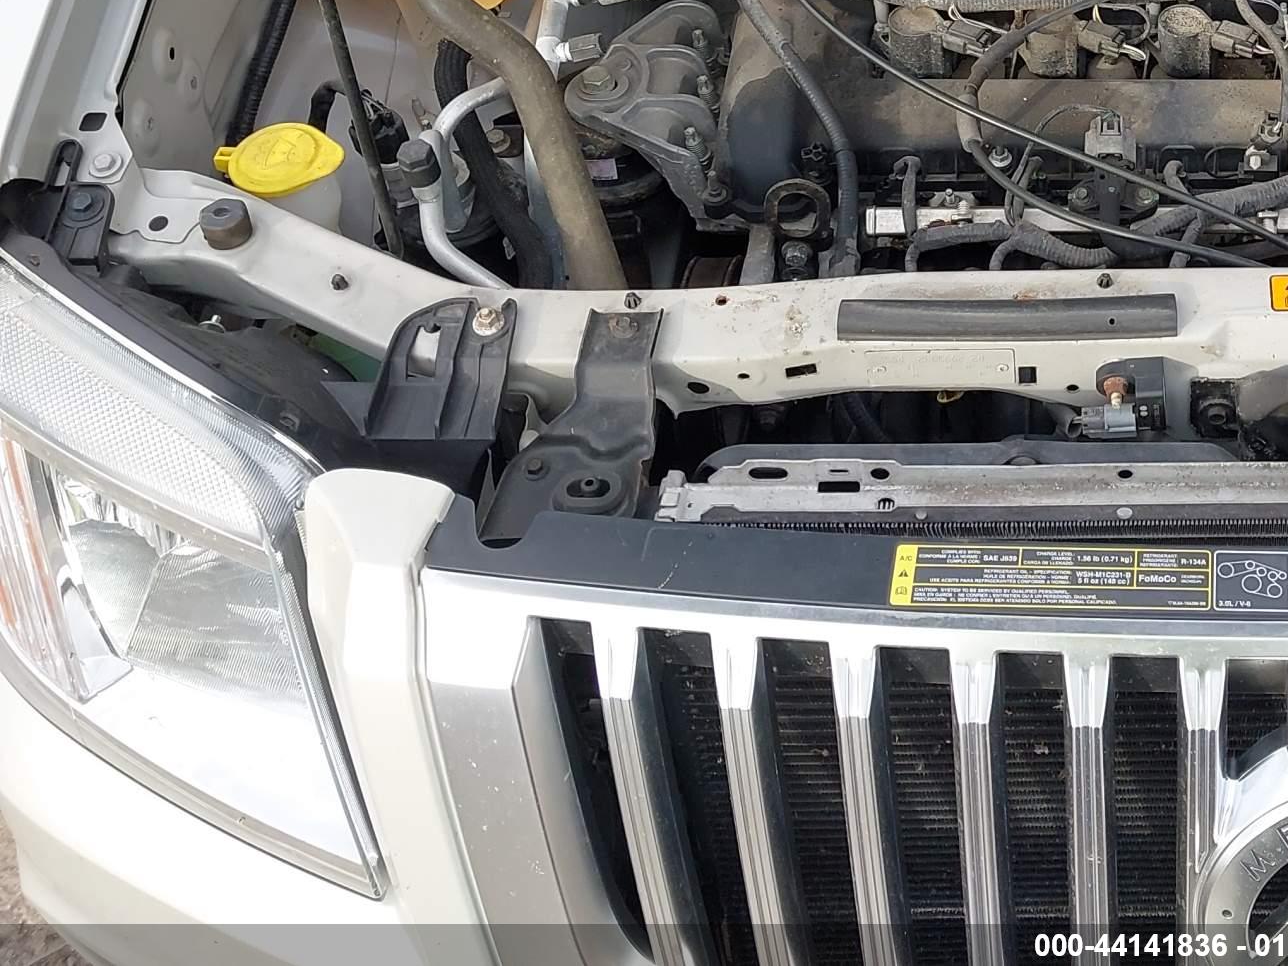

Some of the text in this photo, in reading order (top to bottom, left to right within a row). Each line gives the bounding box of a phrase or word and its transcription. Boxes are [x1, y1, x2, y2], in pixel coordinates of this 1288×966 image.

[983, 554, 998, 562] SAE
[1092, 555, 1100, 563] lb
[1101, 555, 1118, 564] (0.71
[1120, 555, 1133, 565] kg)
[1180, 558, 1207, 566] R-134A
[1138, 574, 1177, 583] FoMoCo
